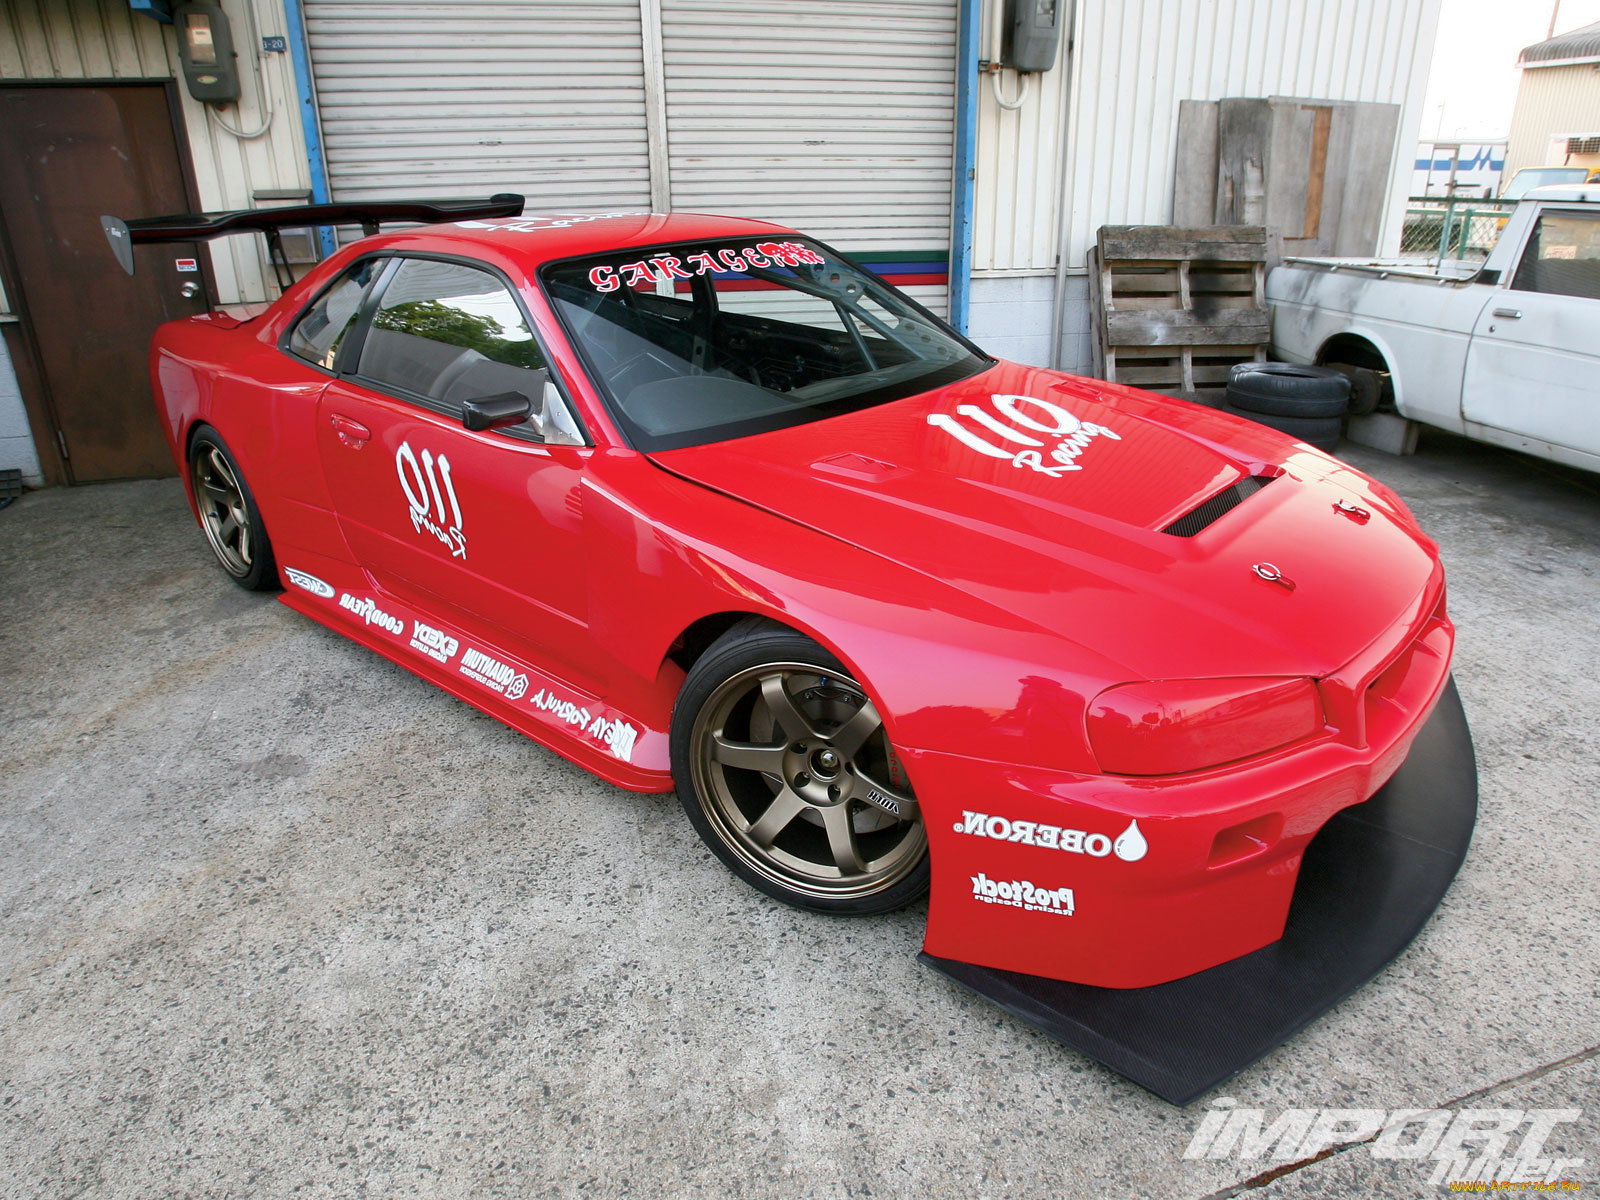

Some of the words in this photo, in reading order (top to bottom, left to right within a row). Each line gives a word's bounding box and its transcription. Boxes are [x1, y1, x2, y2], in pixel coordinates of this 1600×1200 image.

[588, 247, 771, 292] GARAGE
[927, 394, 1082, 459] 110
[1012, 421, 1122, 478] Racing
